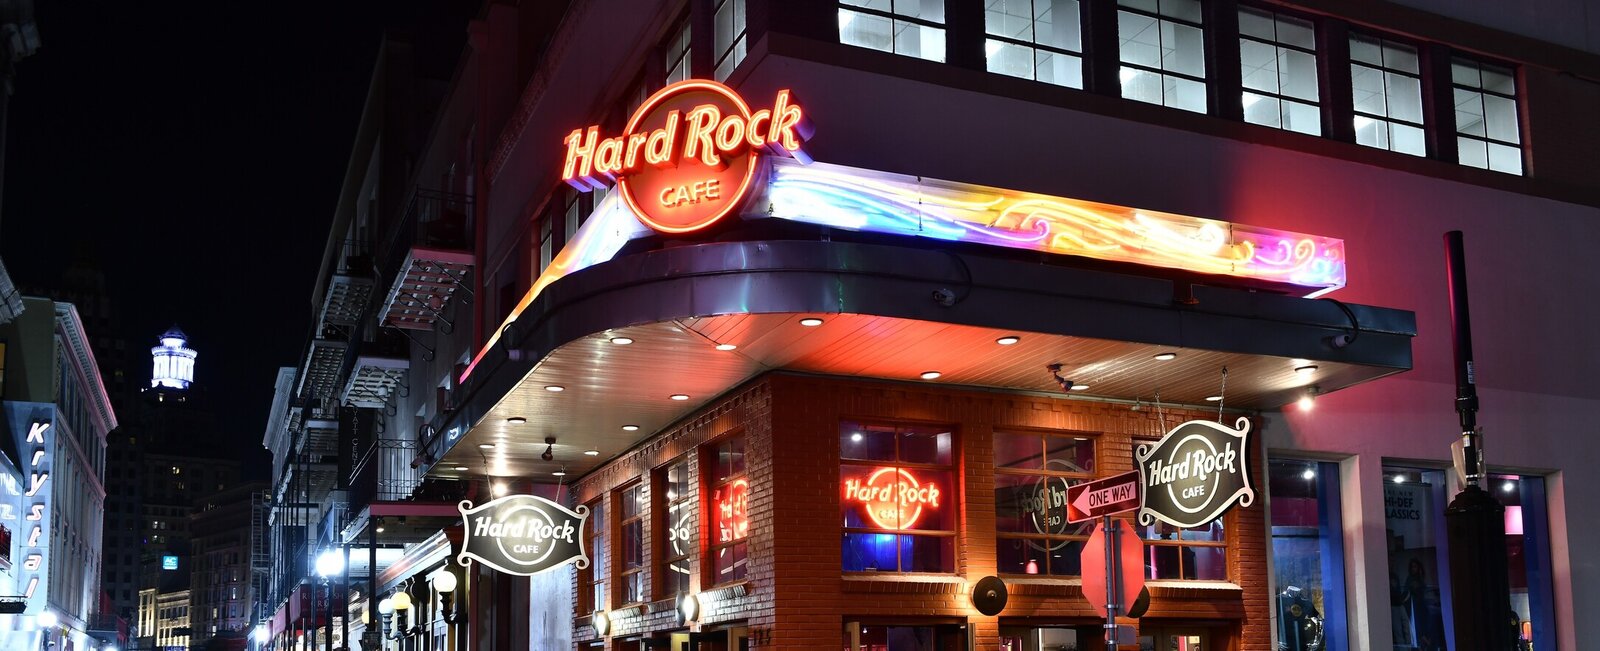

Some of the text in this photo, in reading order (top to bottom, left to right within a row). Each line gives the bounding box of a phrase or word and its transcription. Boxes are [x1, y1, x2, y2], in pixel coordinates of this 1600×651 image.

[562, 89, 803, 182] Hard Rock
[659, 179, 720, 207] CAFE
[1149, 442, 1236, 486] Hard Rock
[845, 479, 939, 507] Hard Rock
[1089, 484, 1132, 507] ONE WAY
[1182, 485, 1205, 499] CAFE
[24, 422, 49, 598] Krystal
[1385, 509, 1420, 520] LASSICS
[474, 515, 575, 544] Hard Rock
[513, 544, 539, 554] CAFE
